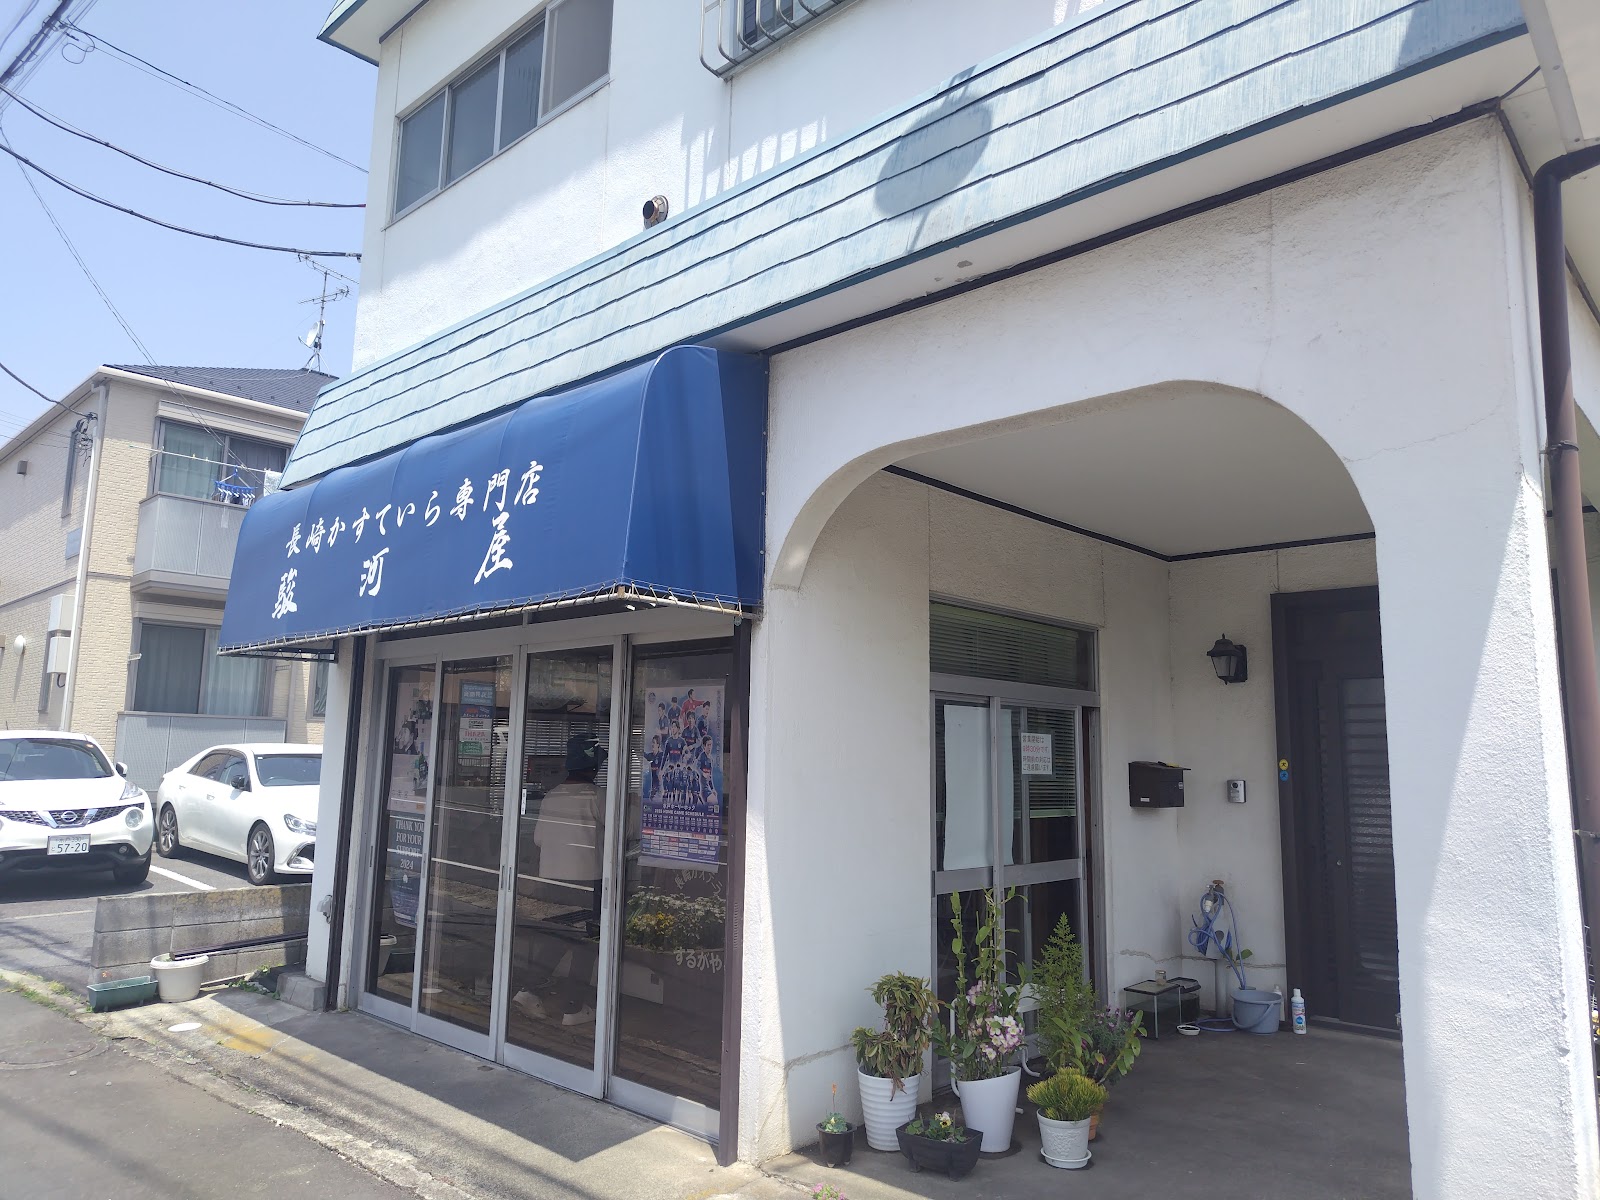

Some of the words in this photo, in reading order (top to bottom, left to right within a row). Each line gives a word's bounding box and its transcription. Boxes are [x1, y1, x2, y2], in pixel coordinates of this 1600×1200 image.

[285, 460, 544, 559] 長崎かすていら専門店
[395, 819, 413, 831] THANK
[414, 821, 425, 833] YOU
[396, 832, 407, 843] FOR
[407, 834, 422, 846] YOUR
[57, 842, 88, 853] 57-20
[673, 946, 723, 974] するがや
